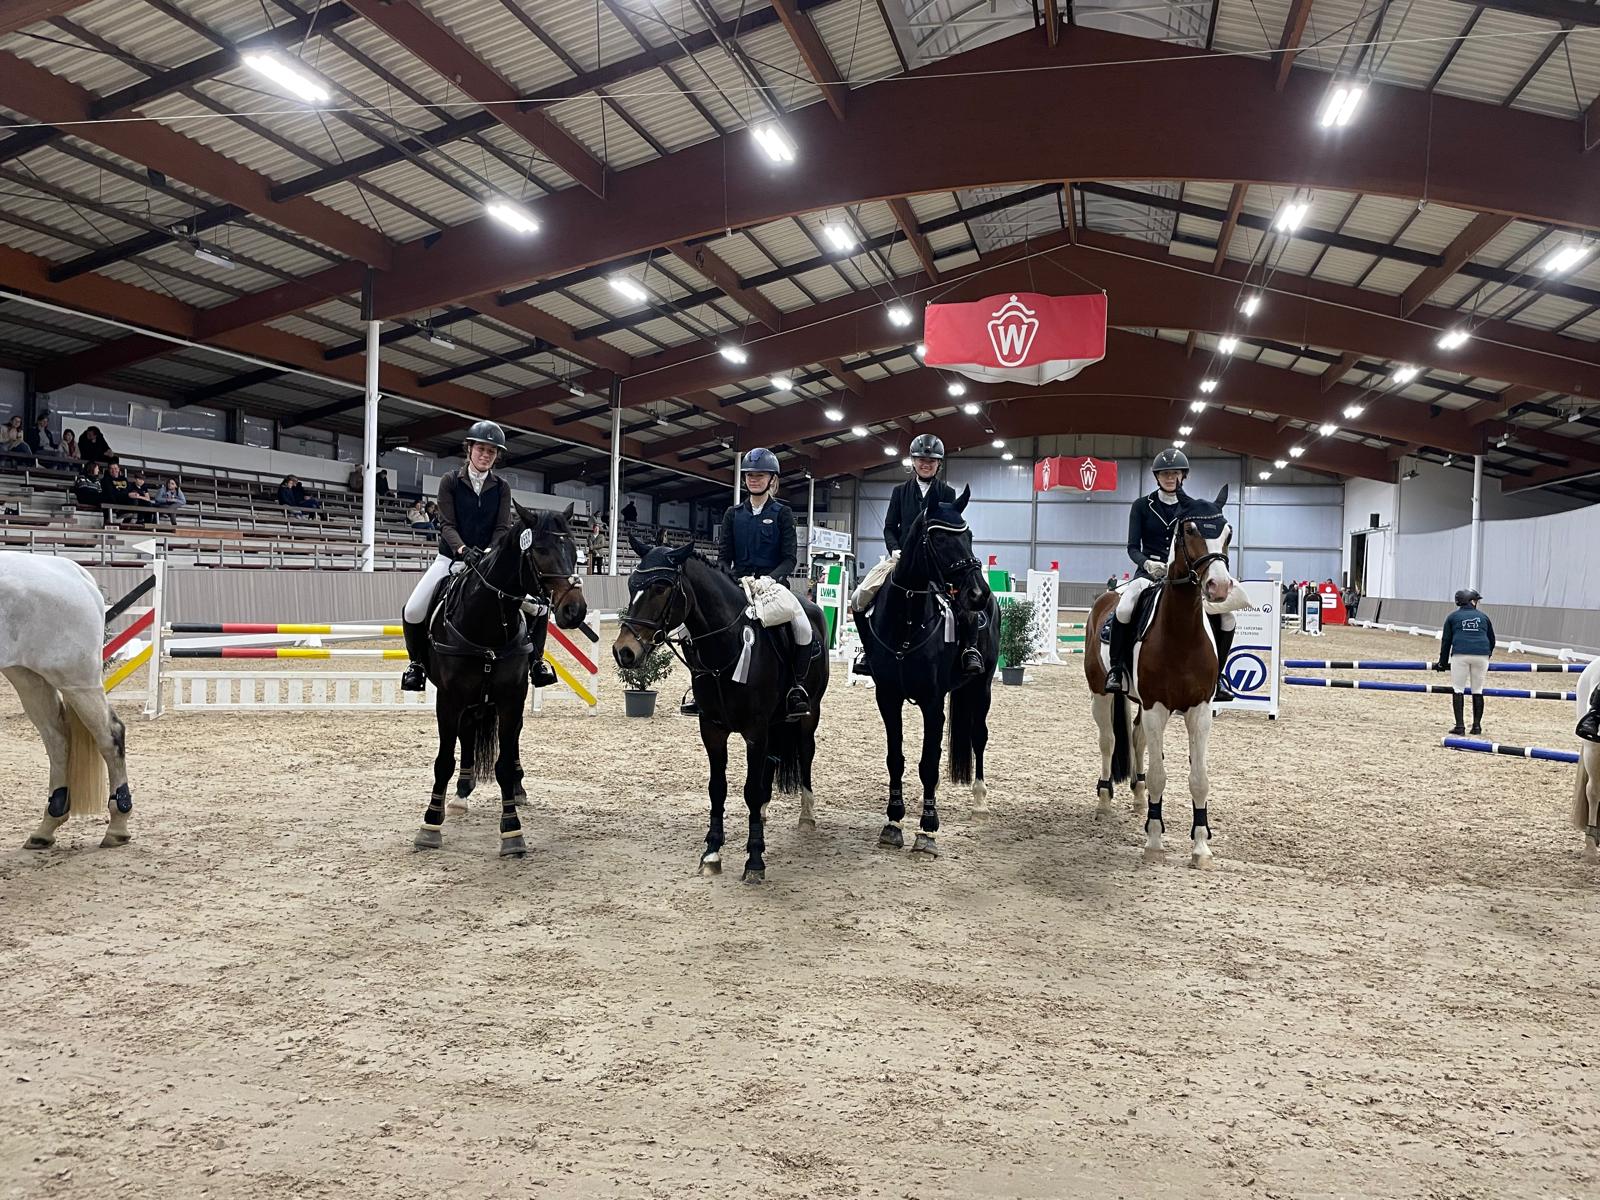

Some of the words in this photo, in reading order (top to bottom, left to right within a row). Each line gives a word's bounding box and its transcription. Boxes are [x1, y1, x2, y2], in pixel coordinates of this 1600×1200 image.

[998, 324, 1028, 356] W
[1083, 470, 1094, 486] W
[820, 587, 832, 597] LVM
